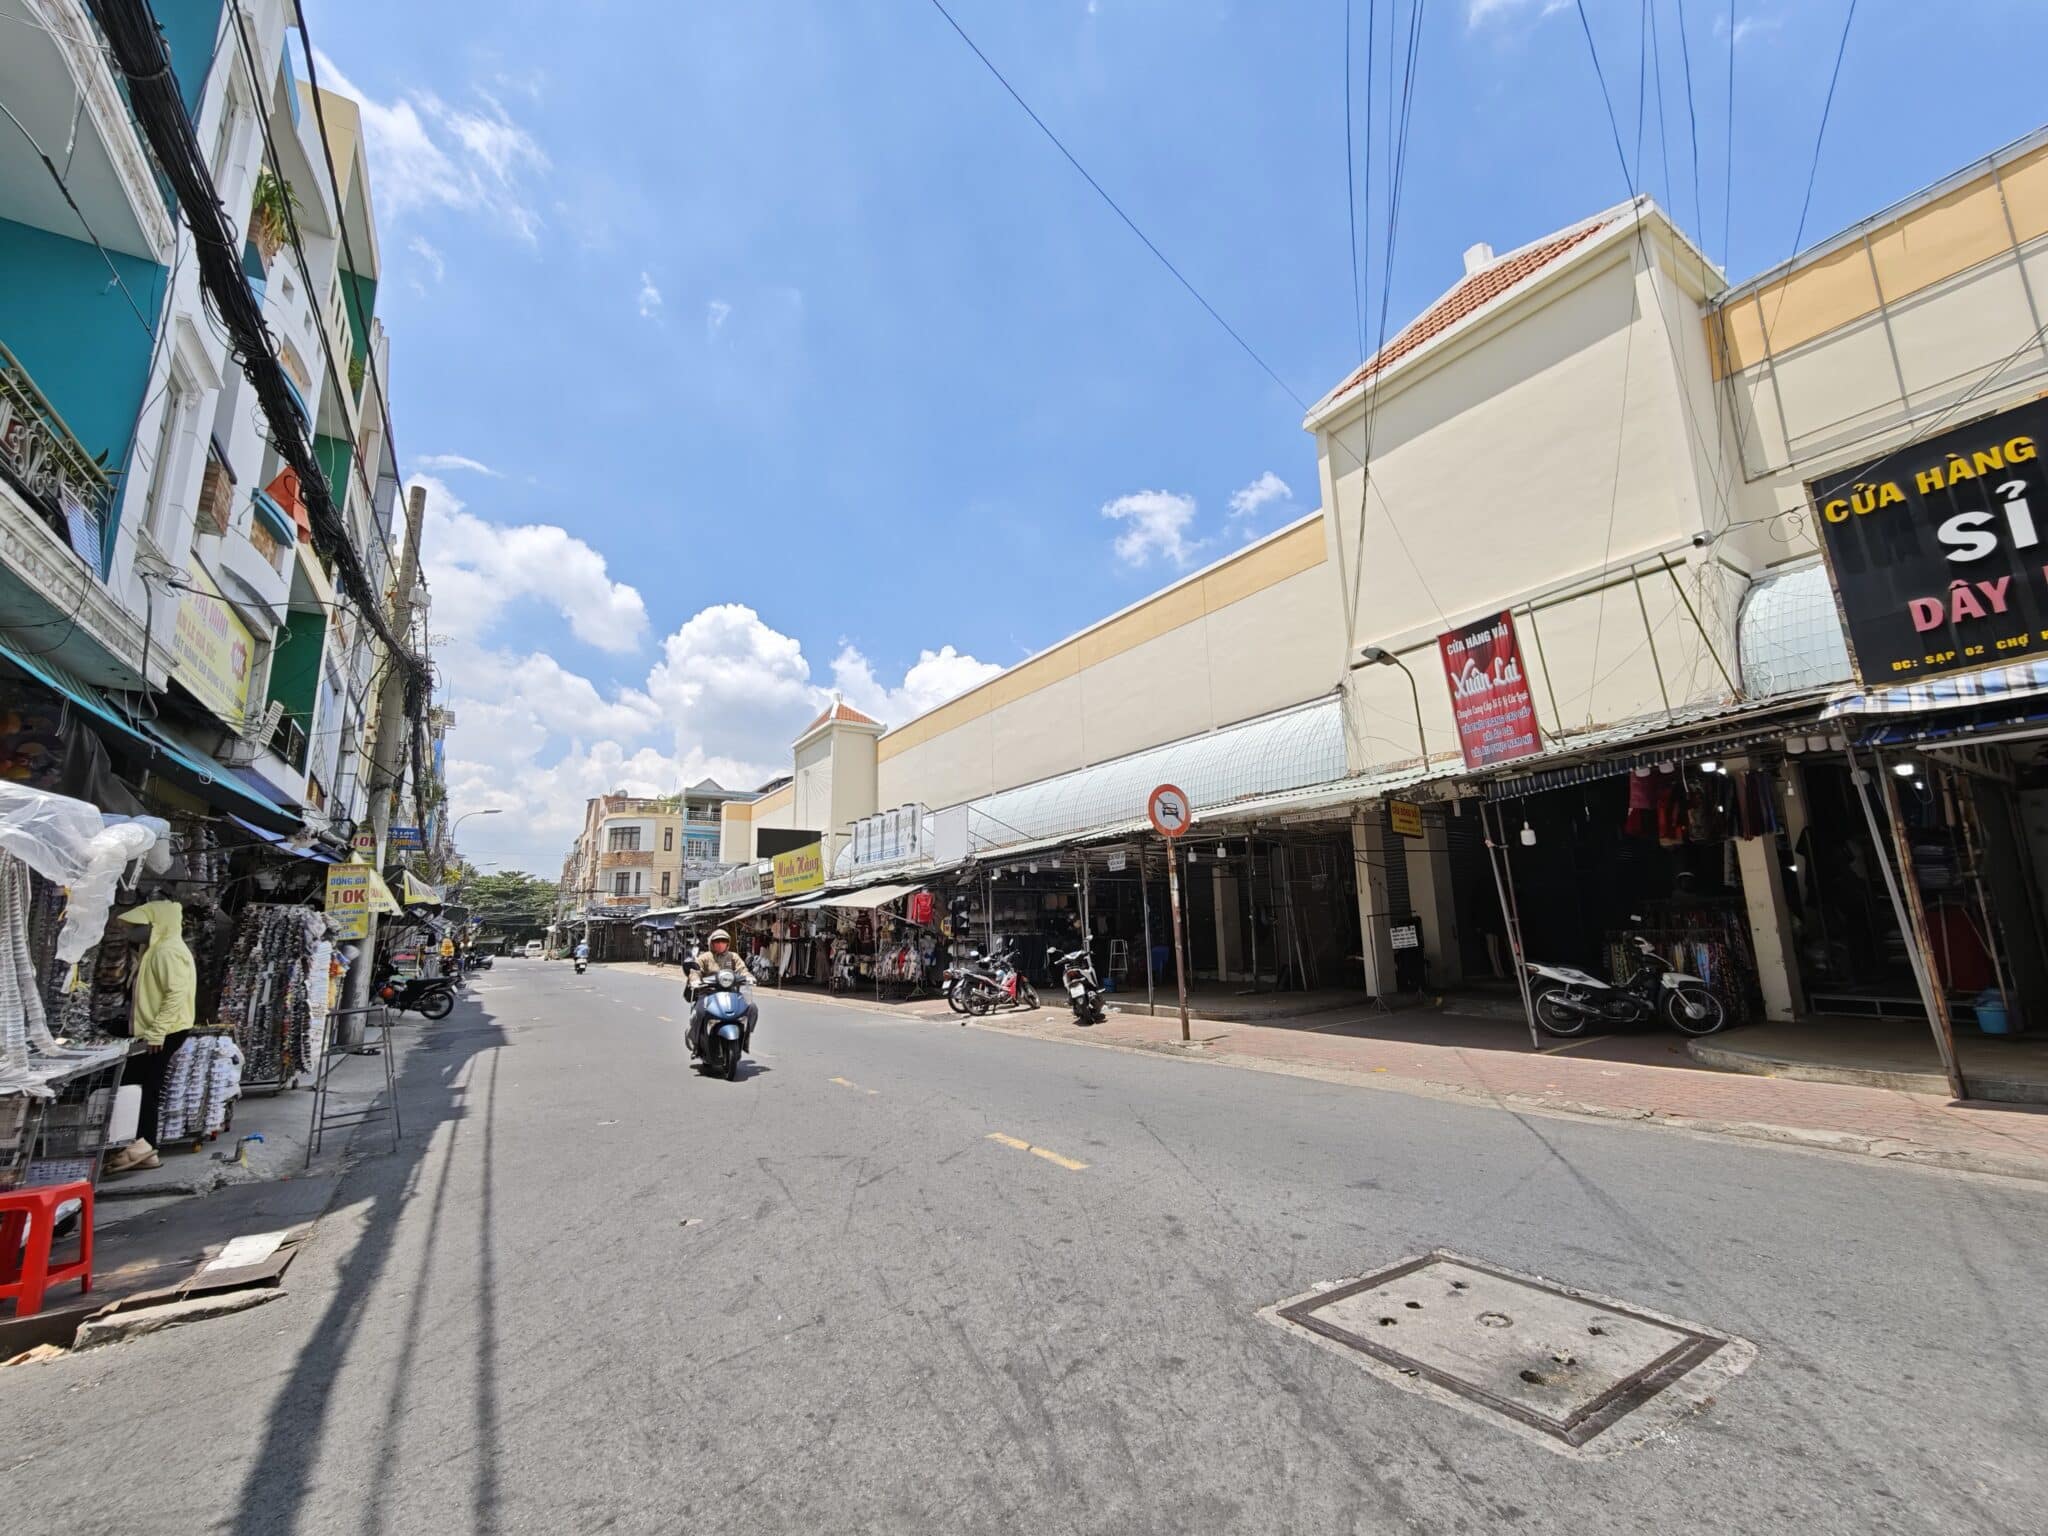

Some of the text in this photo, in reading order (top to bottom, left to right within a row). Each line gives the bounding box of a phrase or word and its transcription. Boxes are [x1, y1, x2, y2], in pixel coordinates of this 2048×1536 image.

[1824, 436, 2038, 523] CỬA HÀNG
[1937, 479, 2039, 562] SỈ
[1908, 575, 2011, 633] DÂY
[1466, 630, 1491, 649] HÀNG
[1491, 621, 1508, 639] VẢI
[1964, 645, 1985, 656] 02
[1451, 657, 1493, 700] Xuân
[331, 889, 366, 904] 10K
